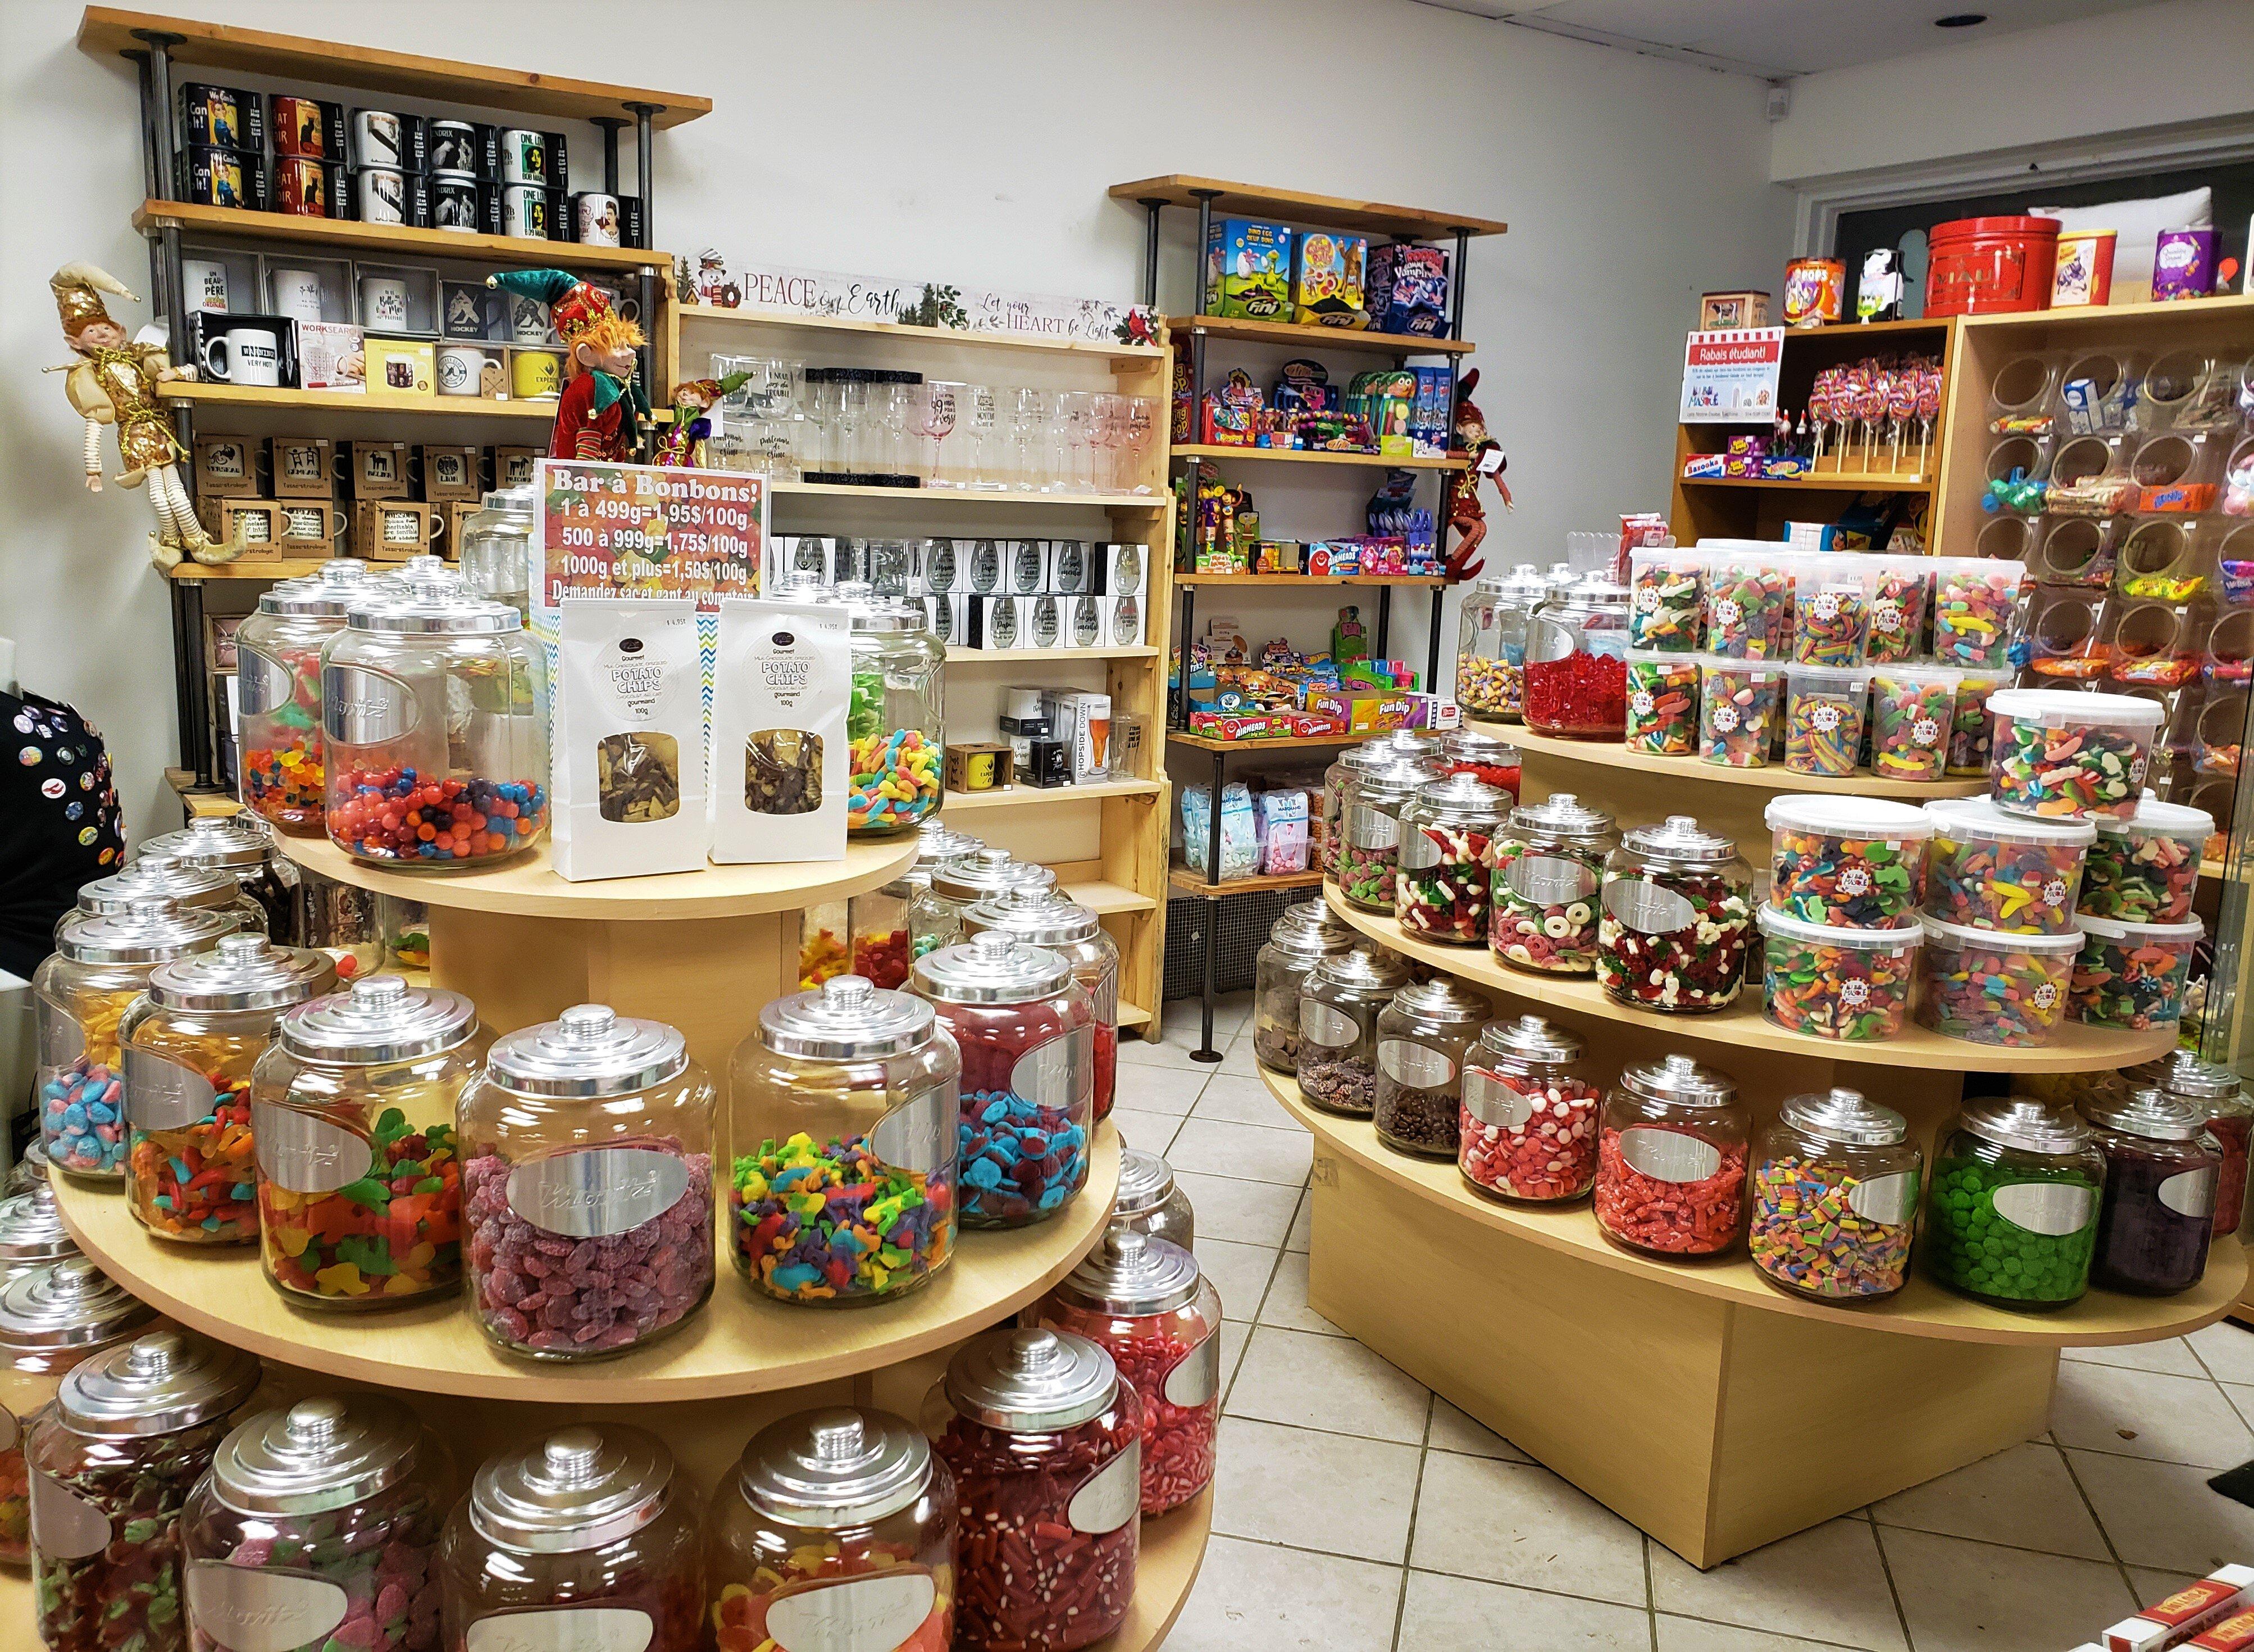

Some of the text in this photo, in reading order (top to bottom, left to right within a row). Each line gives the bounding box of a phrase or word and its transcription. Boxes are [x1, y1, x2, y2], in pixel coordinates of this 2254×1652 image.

[190, 102, 207, 115] Can
[193, 116, 203, 129] It!
[521, 134, 532, 144] ONE
[193, 163, 211, 177] Can
[197, 178, 207, 190] It!
[523, 189, 536, 200] ONE
[1801, 270, 1828, 281] POPS
[205, 285, 224, 295] PÈRE
[744, 273, 900, 316] PEACE on Earth
[981, 293, 1029, 315] Let your
[1007, 314, 1109, 341] HEART be Light
[1700, 347, 1727, 361] Rabais
[767, 450, 785, 459] crime
[1687, 459, 1718, 475] Bazooka
[553, 469, 758, 502] Bar à Bonbons!
[561, 498, 748, 531] 1 à 499g=1,95$/100g
[562, 527, 748, 558] 500 à 999g=1,75$/100g
[1328, 552, 1356, 567] AIRHEADS
[562, 555, 747, 585] 1000g et plus=1,50$/100g
[552, 579, 617, 600] Demandez
[685, 590, 698, 604] au
[996, 620, 1012, 629] Papi
[612, 667, 663, 681] POTATO
[762, 662, 810, 673] POTATO
[617, 679, 662, 693] CHIPS
[766, 674, 808, 685] CHIPS
[627, 698, 655, 707] gourmand
[1315, 698, 1342, 717] Fun Dip
[1379, 701, 1410, 717] Fun Dip
[1236, 721, 1266, 739] AIRHEADS
[1308, 723, 1331, 735] AIRHEADS
